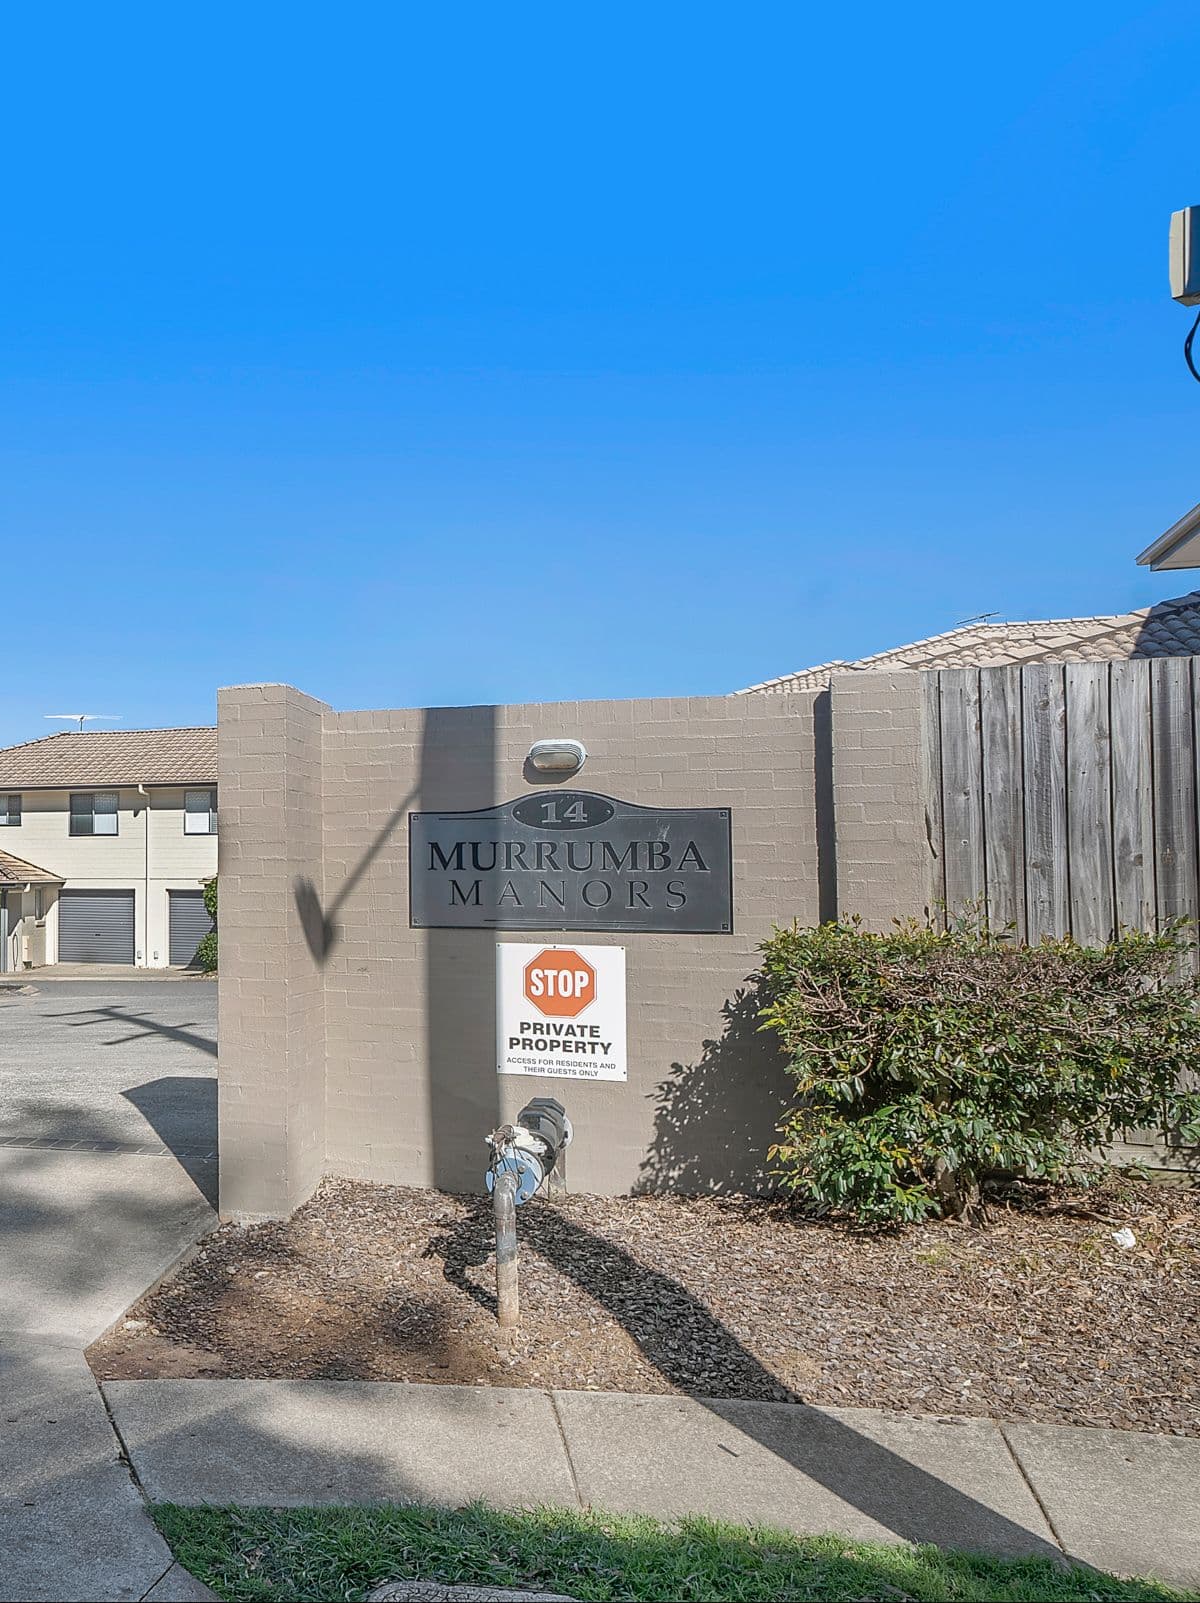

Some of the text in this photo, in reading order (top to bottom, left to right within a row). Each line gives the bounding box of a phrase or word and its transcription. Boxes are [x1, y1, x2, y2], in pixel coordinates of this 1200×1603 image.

[541, 800, 588, 823] 14
[427, 840, 711, 873] MURRUMBA
[448, 879, 687, 909] MANORS
[530, 968, 589, 998] STOP
[519, 1021, 601, 1038] PRIVATE
[508, 1037, 612, 1055] PROPERTY
[506, 1057, 537, 1065] ACCESS
[556, 1060, 598, 1069] RESIDENTS
[547, 1067, 577, 1075] GUESTS
